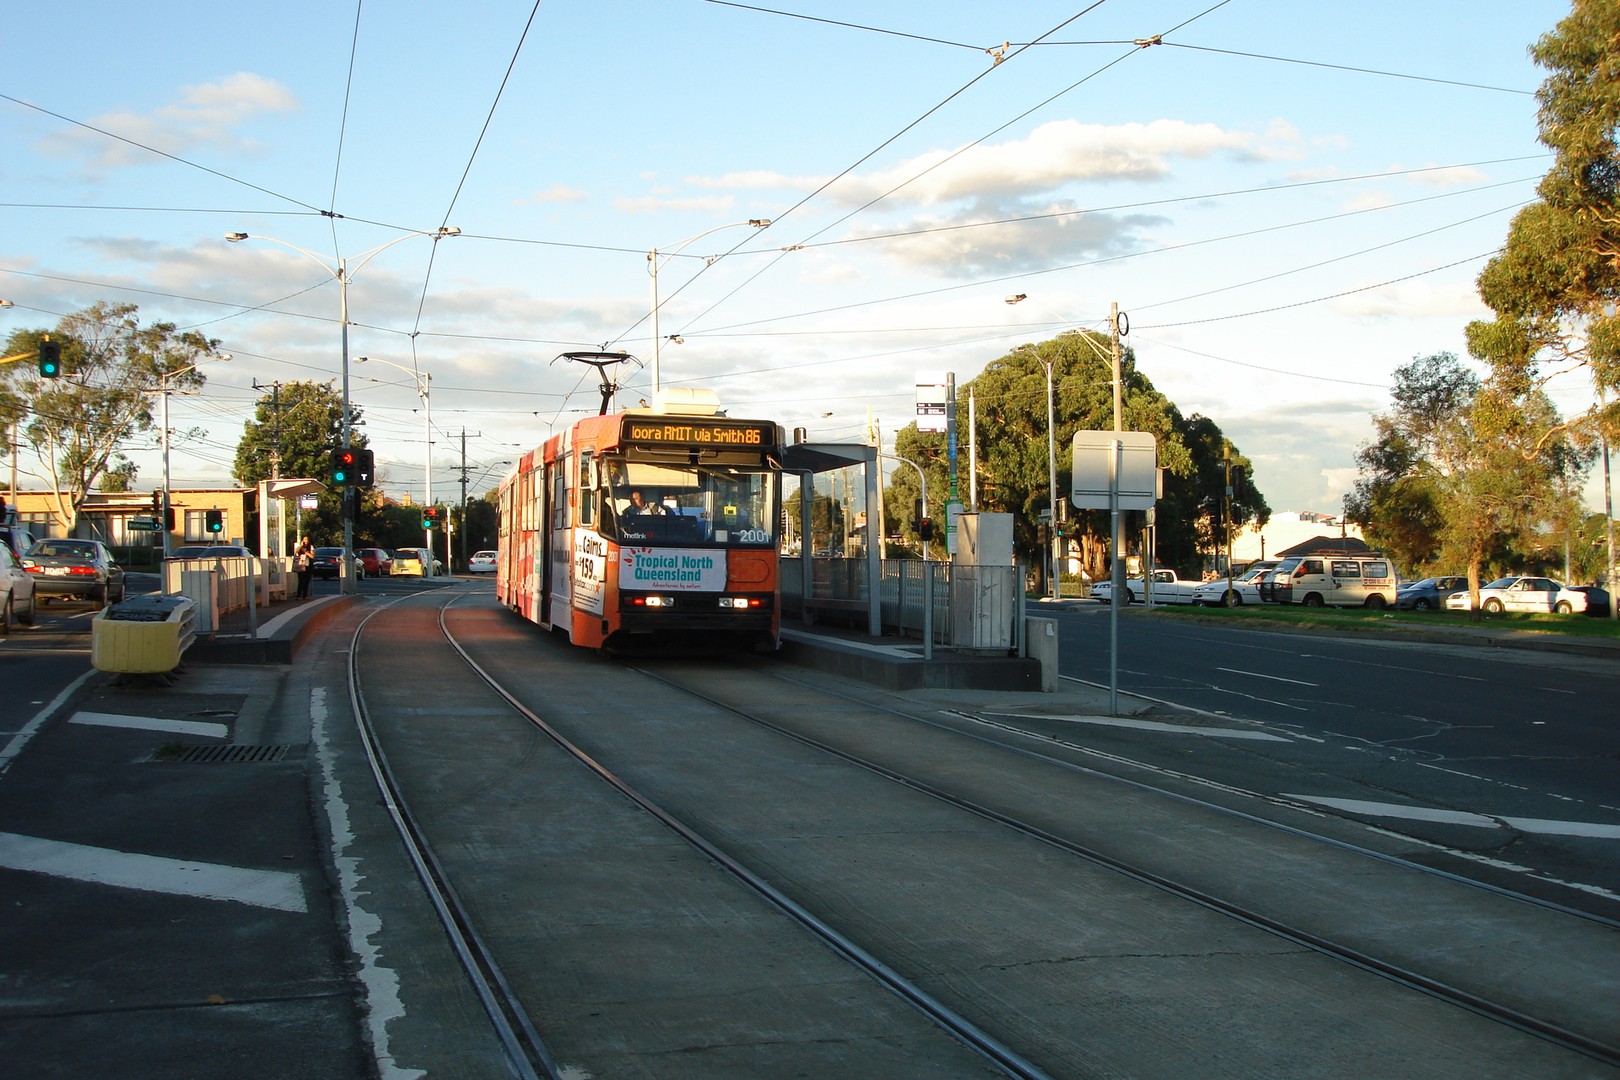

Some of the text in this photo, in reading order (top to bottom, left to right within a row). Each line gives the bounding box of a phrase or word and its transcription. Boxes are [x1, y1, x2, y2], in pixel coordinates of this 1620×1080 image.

[664, 425, 692, 441] RMIT
[695, 428, 710, 442] via
[713, 428, 745, 443] Smith
[745, 429, 760, 443] 86
[740, 529, 769, 543] 2001
[583, 535, 602, 557] Cairns
[634, 554, 713, 569] Tropical North
[634, 567, 701, 581] Queensland
